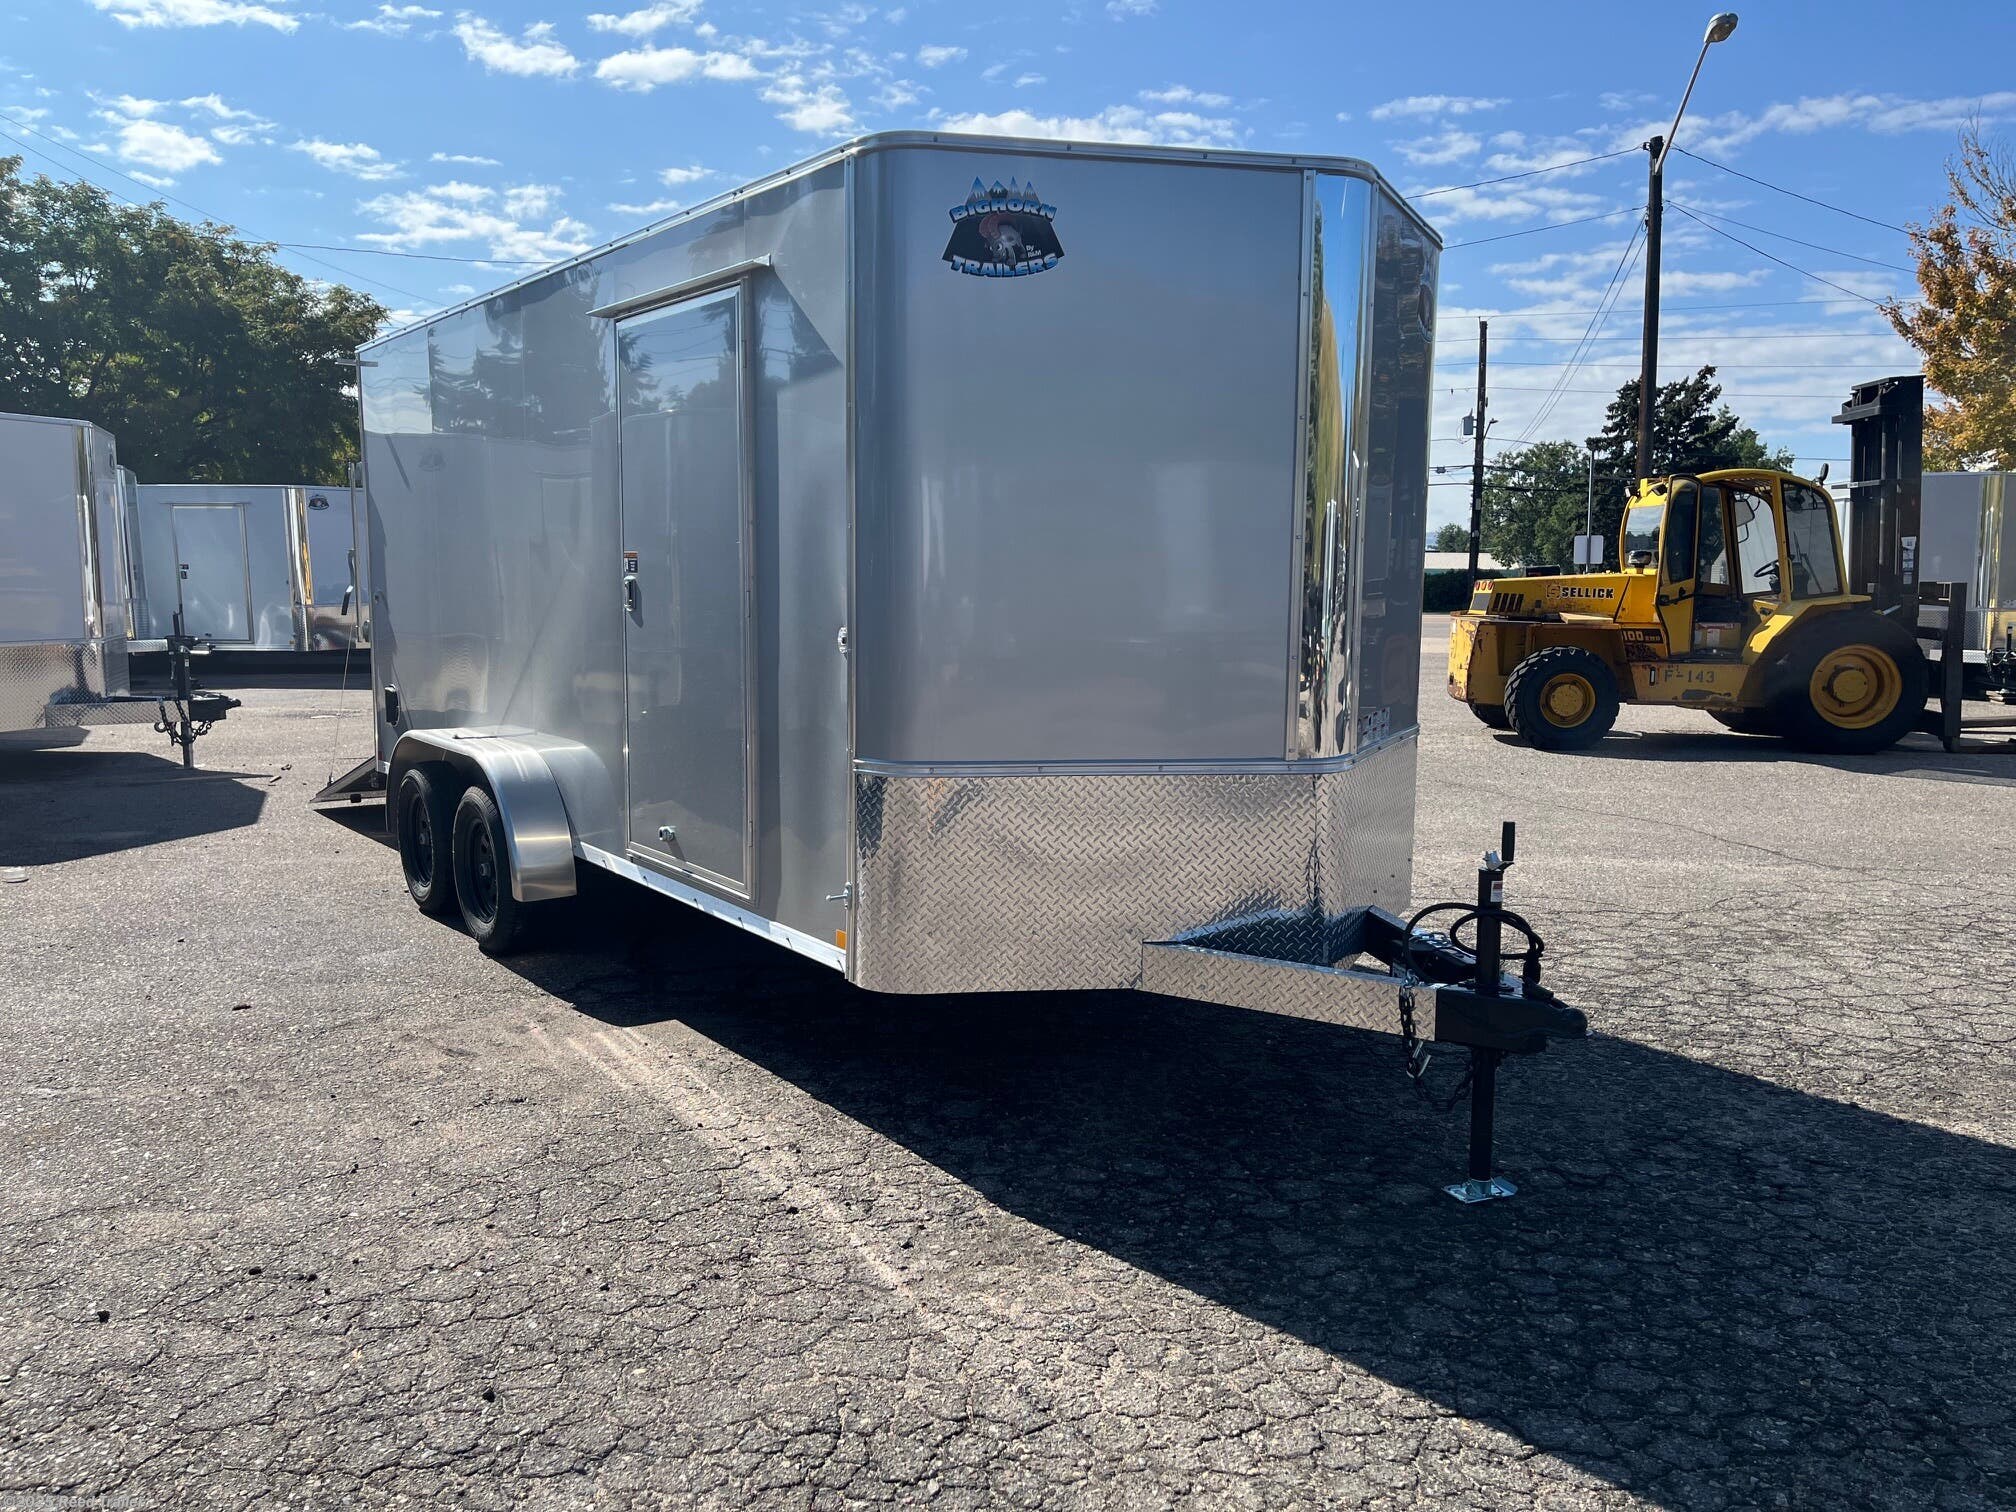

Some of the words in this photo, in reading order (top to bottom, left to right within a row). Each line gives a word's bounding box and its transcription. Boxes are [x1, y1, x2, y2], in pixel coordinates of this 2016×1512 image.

[949, 199, 1058, 223] BIGHORN
[950, 253, 1059, 277] TRAILERS
[1561, 587, 1614, 599] SELLICK
[1623, 631, 1644, 641] 100
